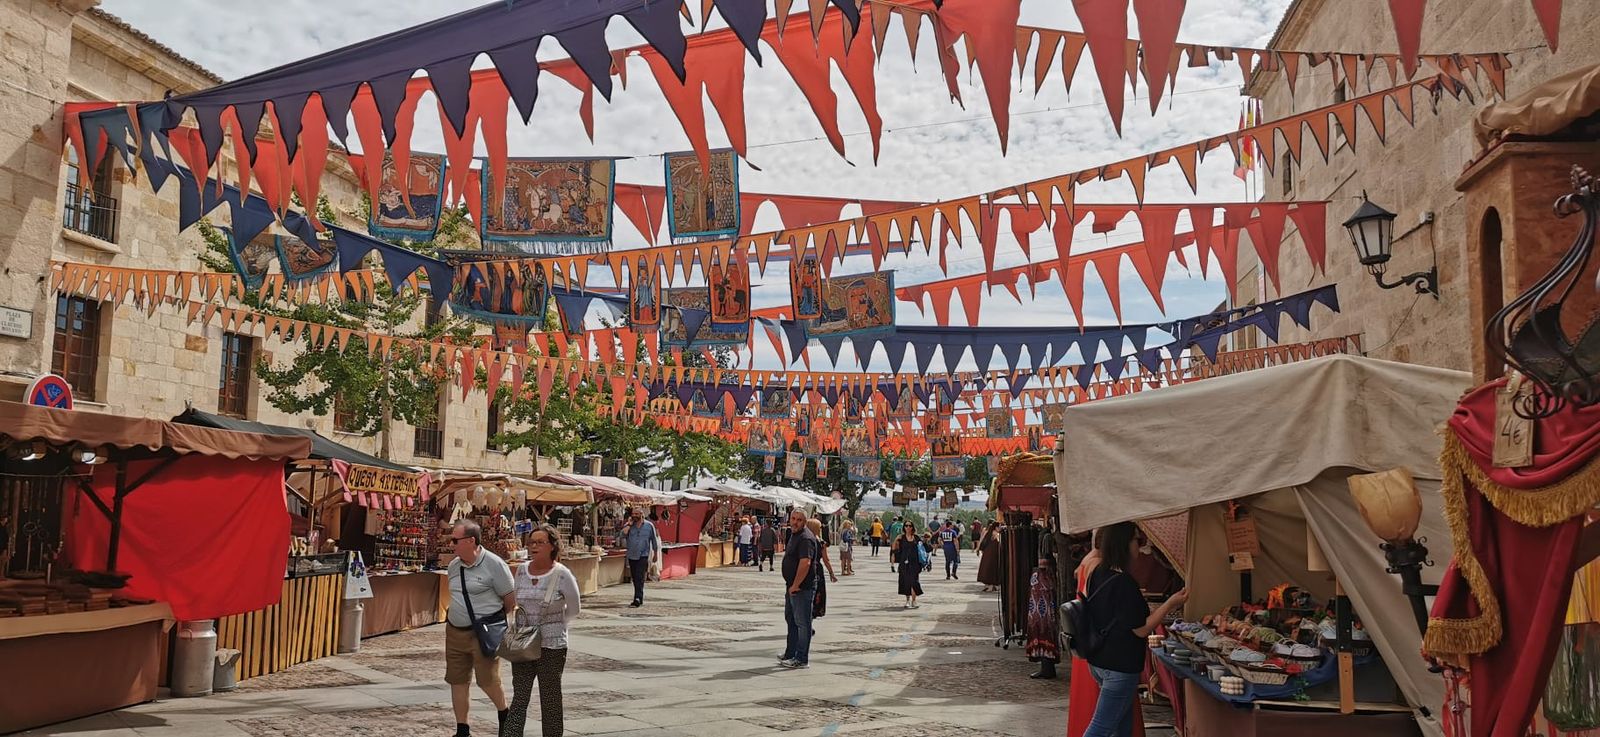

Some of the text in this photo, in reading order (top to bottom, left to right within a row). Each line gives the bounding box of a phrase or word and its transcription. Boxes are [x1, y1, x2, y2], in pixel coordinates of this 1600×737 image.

[1502, 414, 1523, 447] 4€
[349, 467, 418, 493] QUESO ARTESANO
